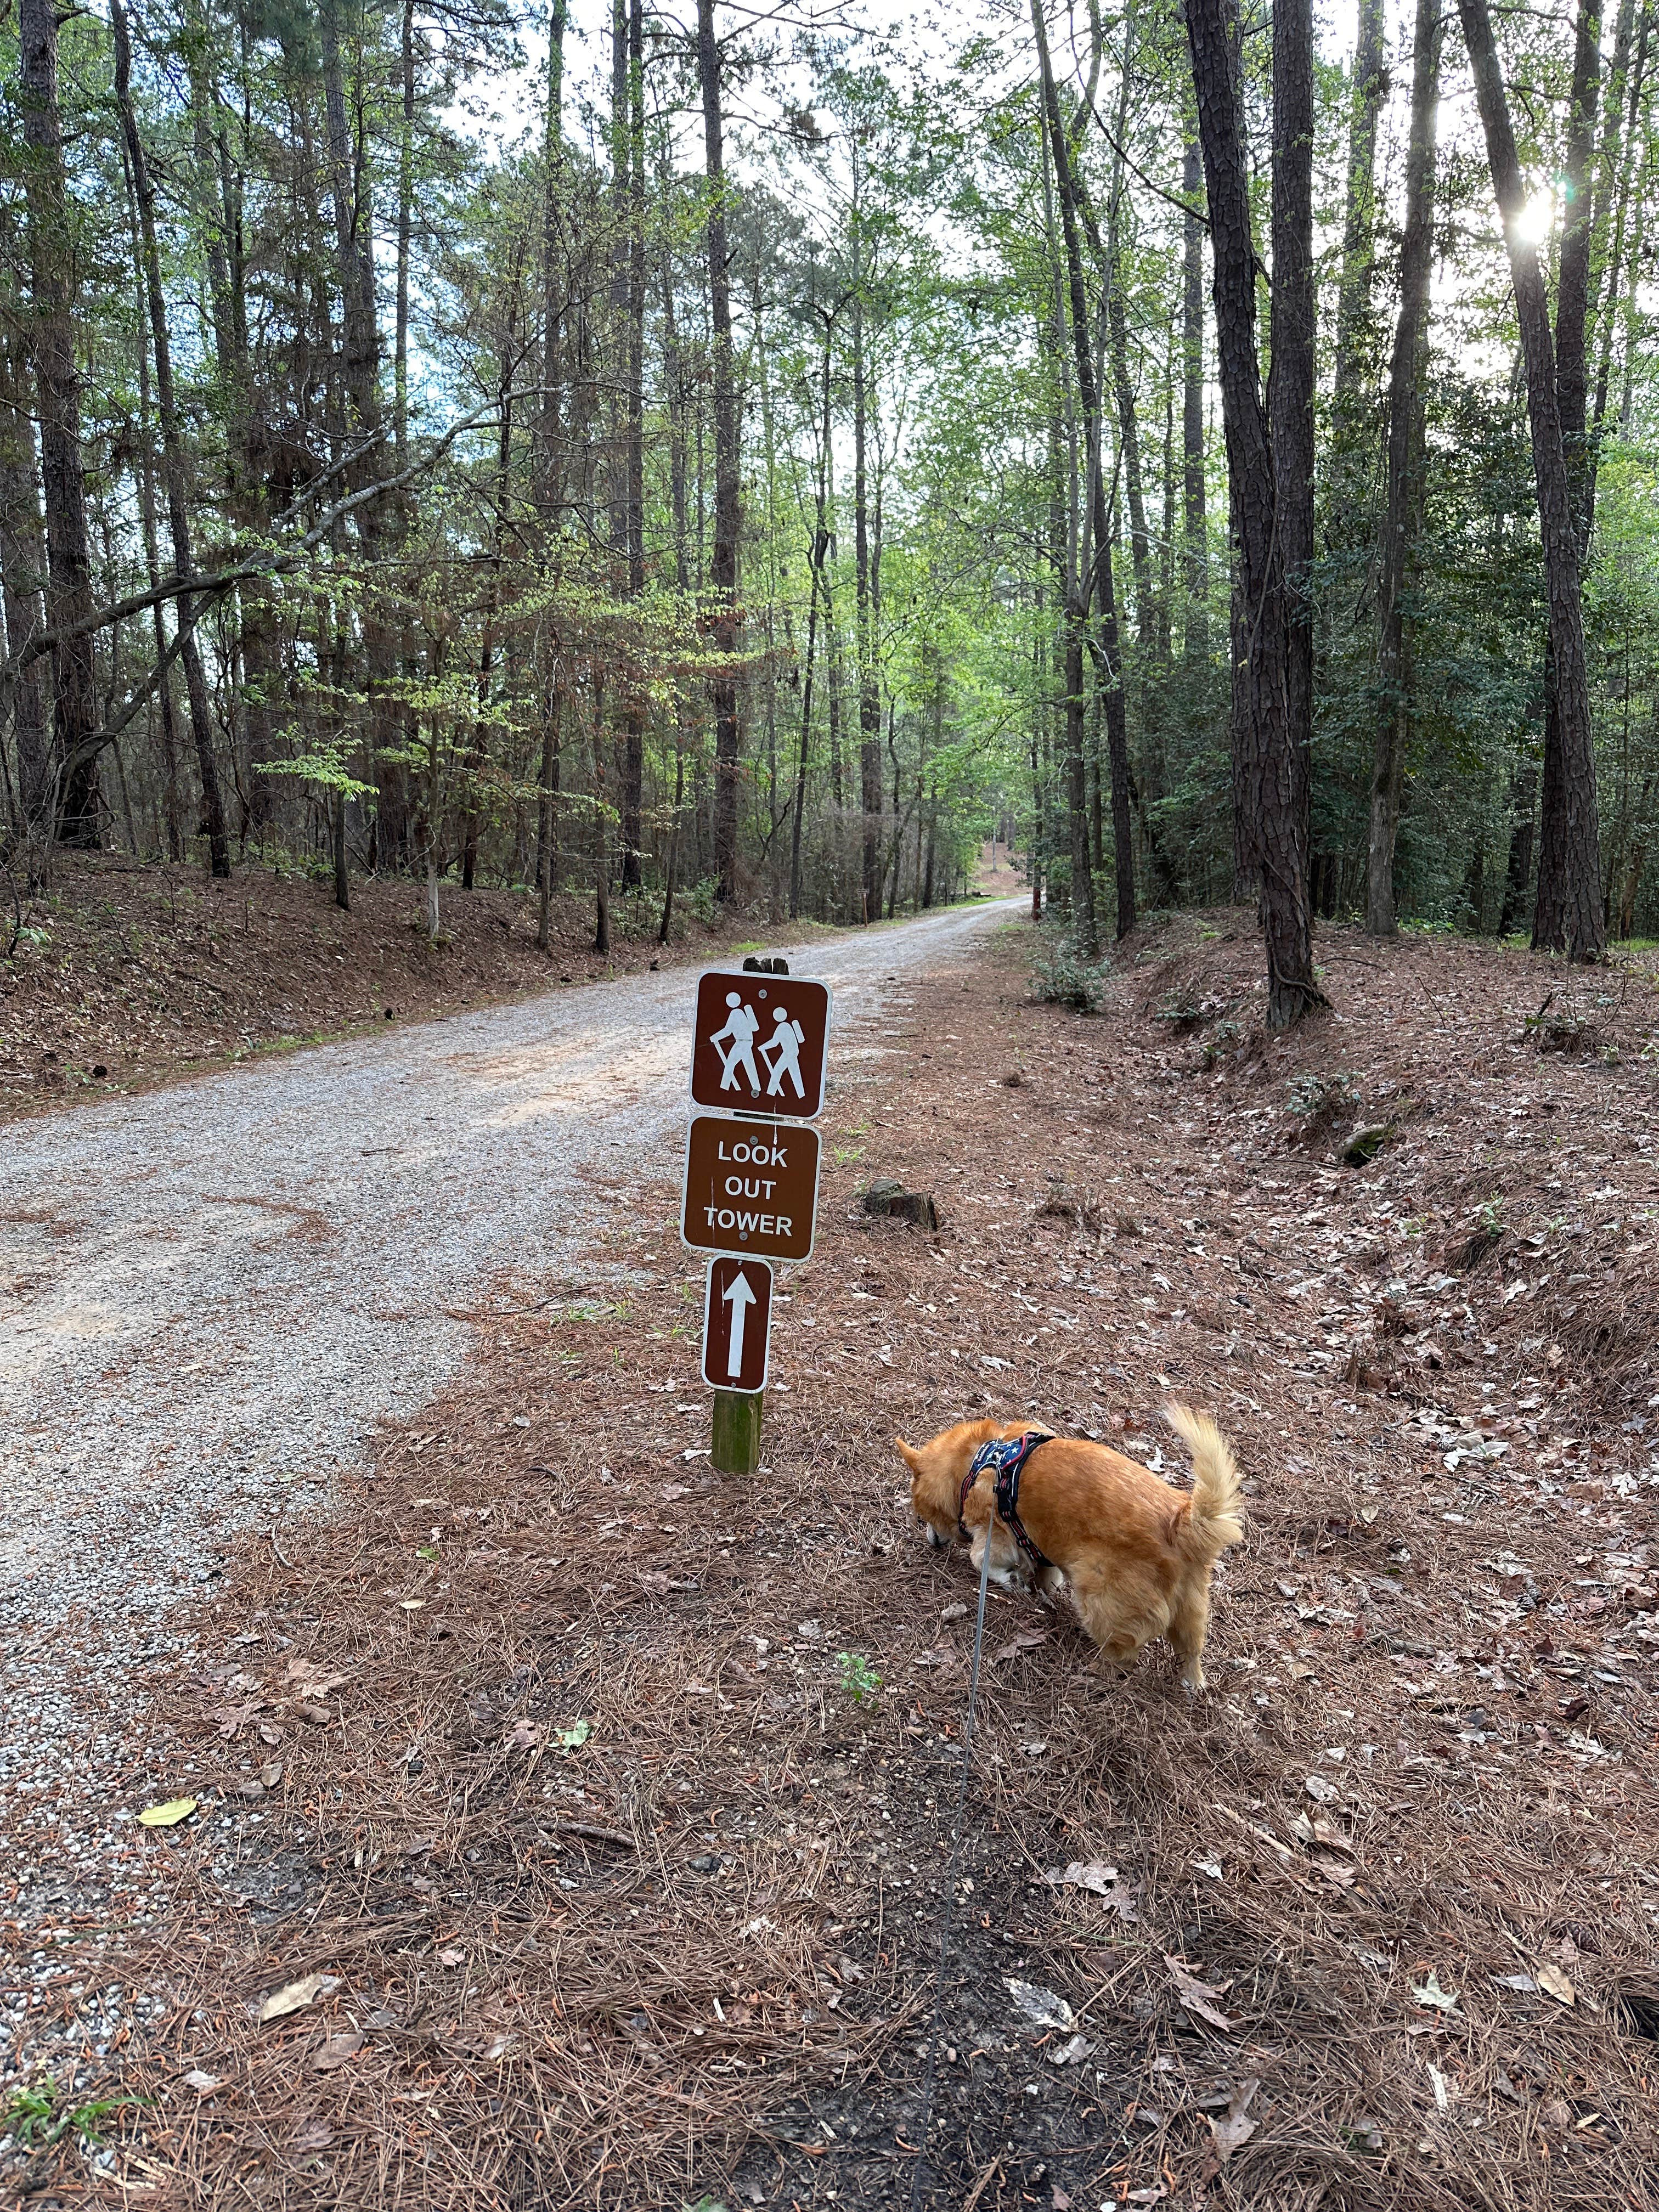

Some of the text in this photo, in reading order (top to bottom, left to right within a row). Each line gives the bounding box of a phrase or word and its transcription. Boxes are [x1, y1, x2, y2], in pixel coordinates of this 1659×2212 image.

[718, 1141, 788, 1167] LOOK
[725, 1176, 776, 1200] OUT
[703, 1207, 792, 1237] TOWER
